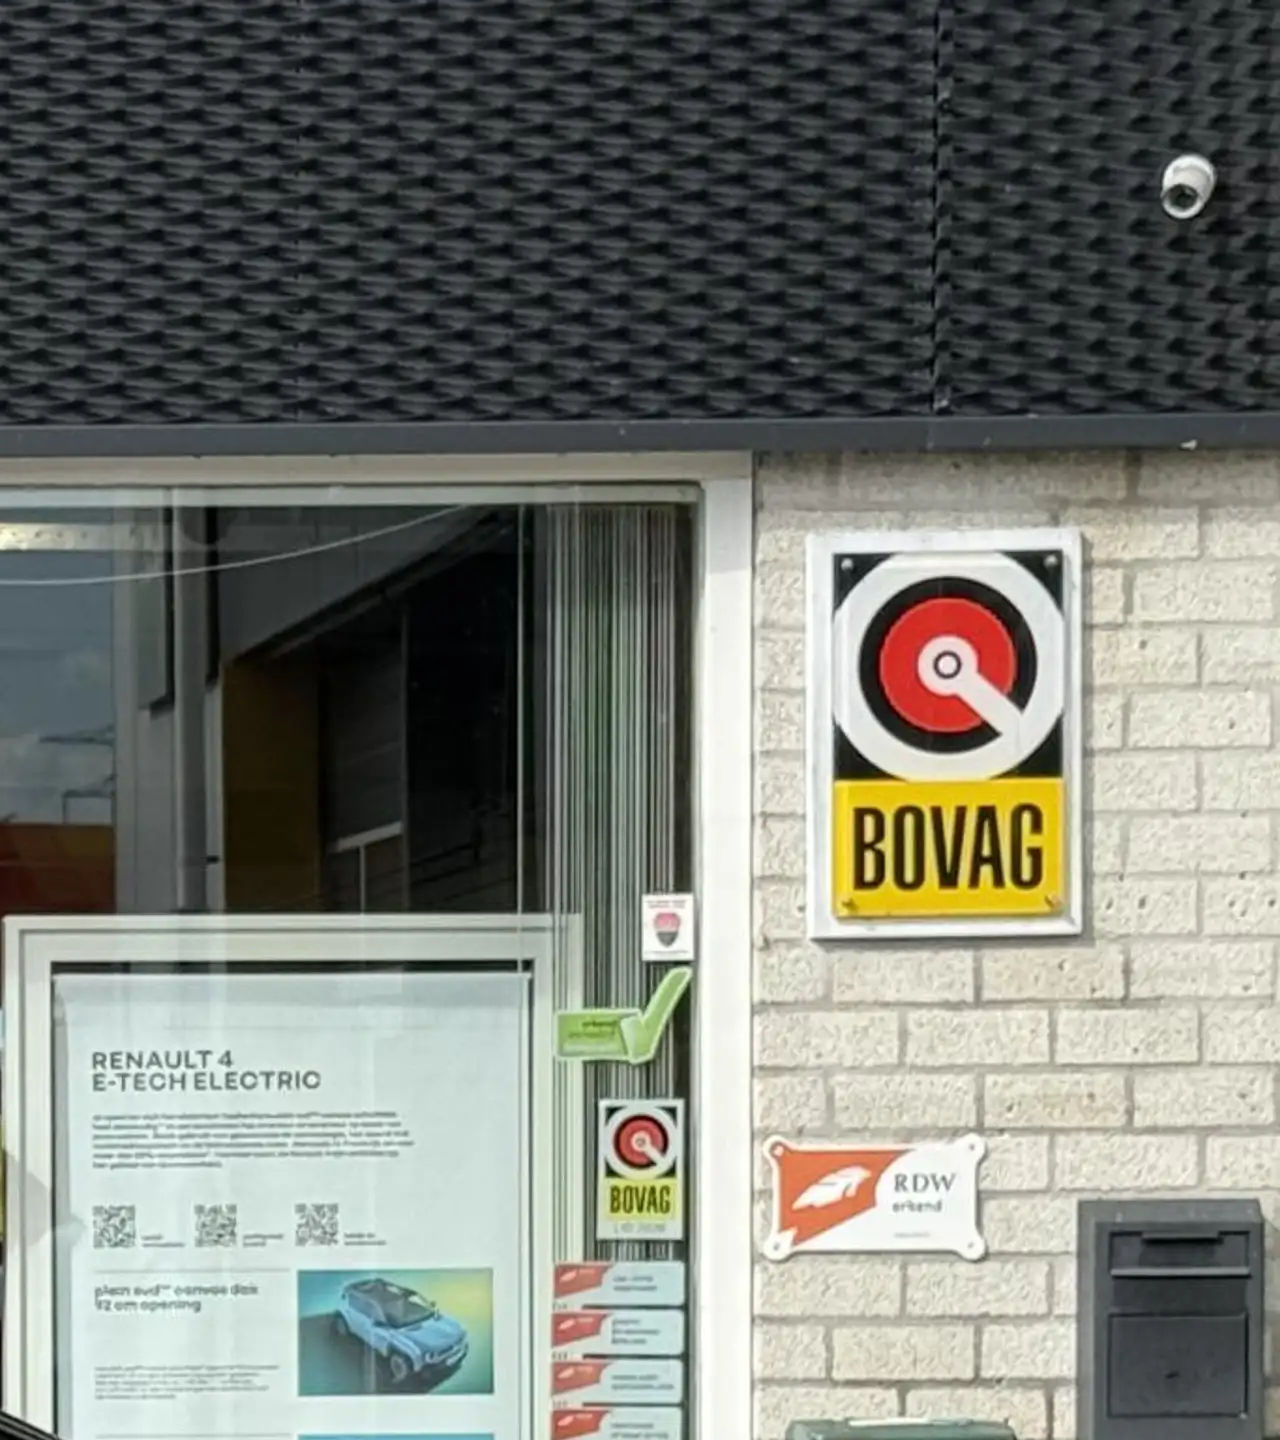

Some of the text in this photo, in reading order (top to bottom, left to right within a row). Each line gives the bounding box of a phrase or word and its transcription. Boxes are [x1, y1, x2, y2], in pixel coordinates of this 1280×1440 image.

[853, 803, 1043, 891] BOVAG
[92, 1049, 234, 1070] RENAULT 4
[92, 1070, 322, 1092] E-TECH ELECTRIC
[893, 1172, 957, 1193] RDW
[610, 1185, 671, 1214] BOVAG
